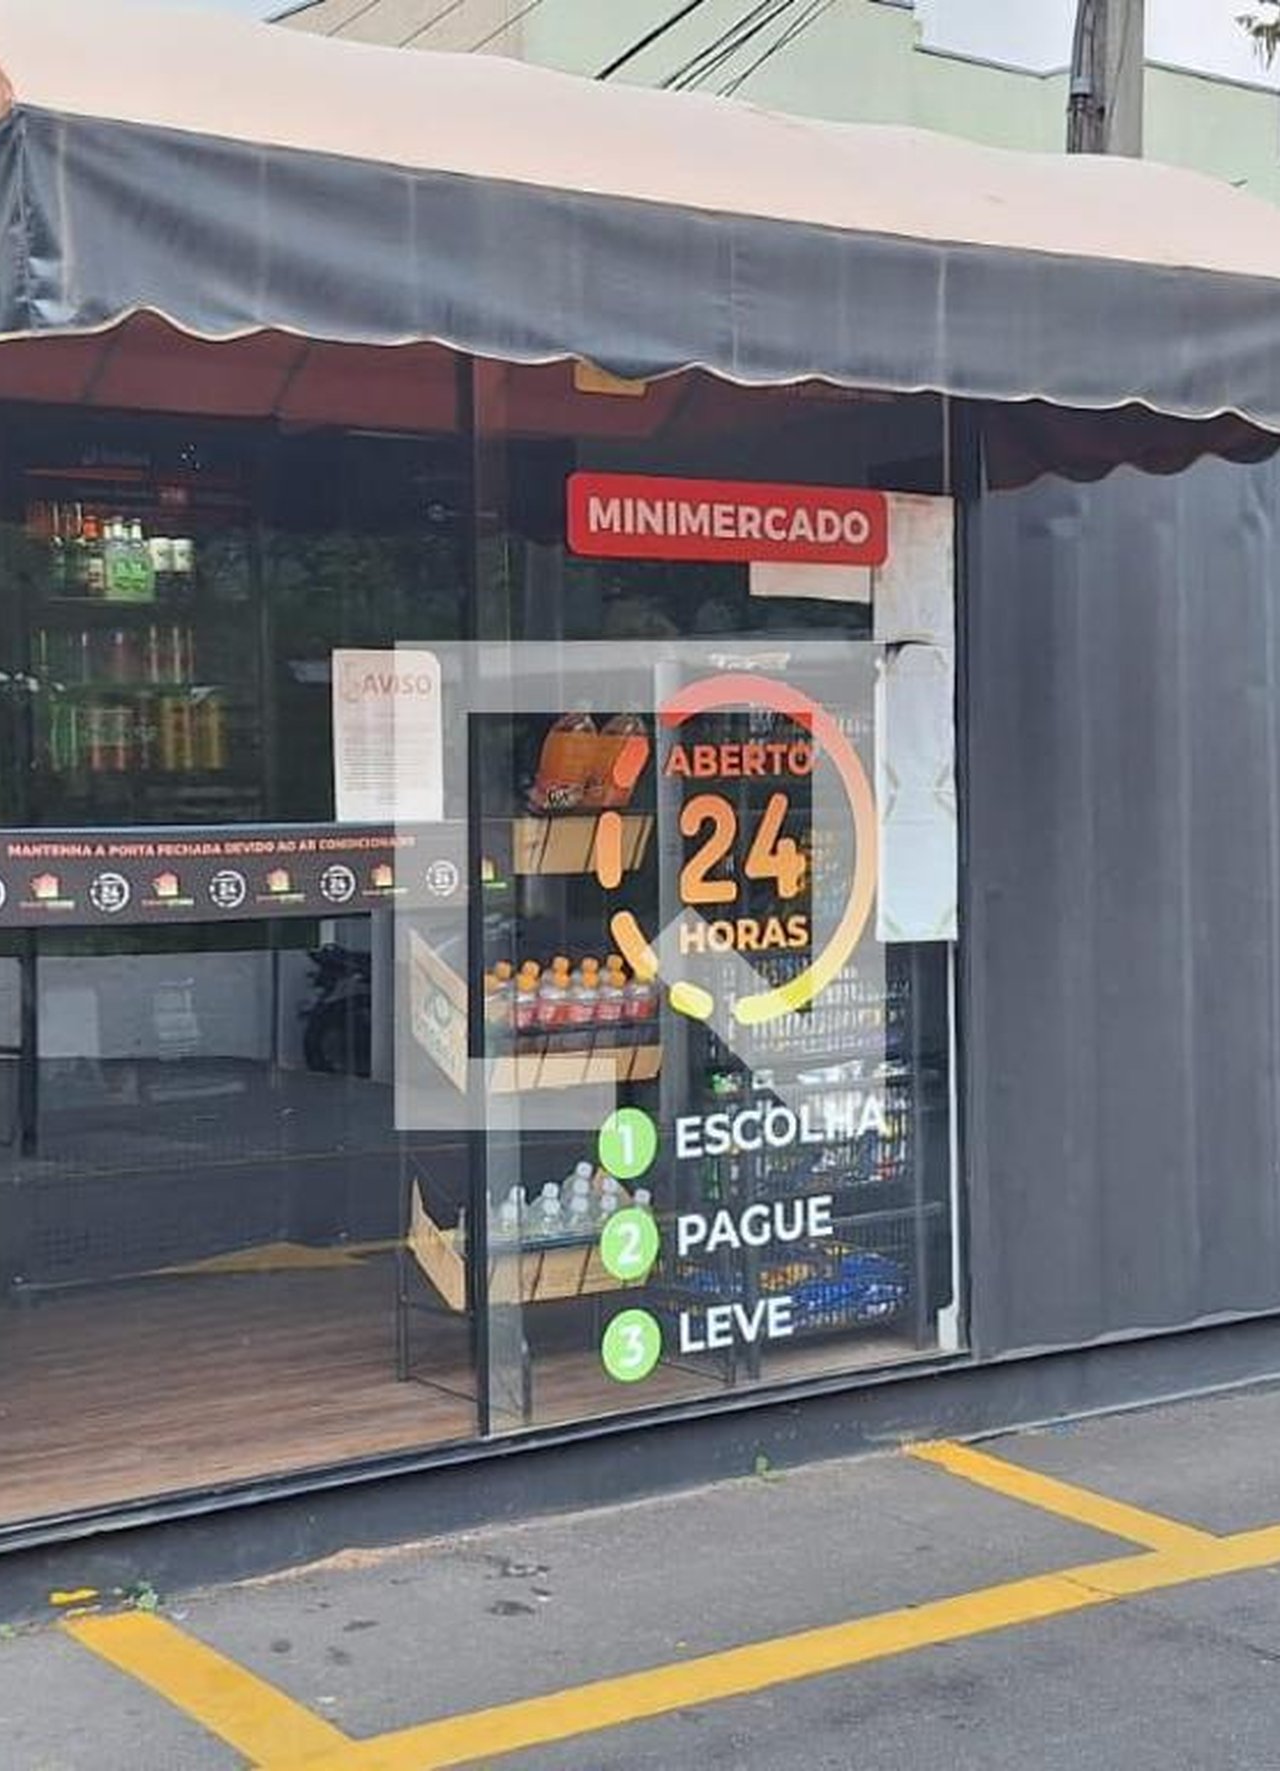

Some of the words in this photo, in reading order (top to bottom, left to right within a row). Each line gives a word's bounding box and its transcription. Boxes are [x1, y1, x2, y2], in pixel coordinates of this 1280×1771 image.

[587, 496, 870, 545] MINIMERCADO
[362, 674, 432, 695] AVISO
[665, 742, 814, 777] ABERTO
[678, 792, 809, 905] 24
[678, 915, 810, 954] HORAS
[617, 1123, 636, 1164] 1
[676, 1098, 888, 1159] ESCOLHA
[617, 1222, 642, 1267] 2
[677, 1195, 834, 1256] PAGUE
[620, 1321, 645, 1365] 3
[678, 1296, 794, 1353] LEVE
